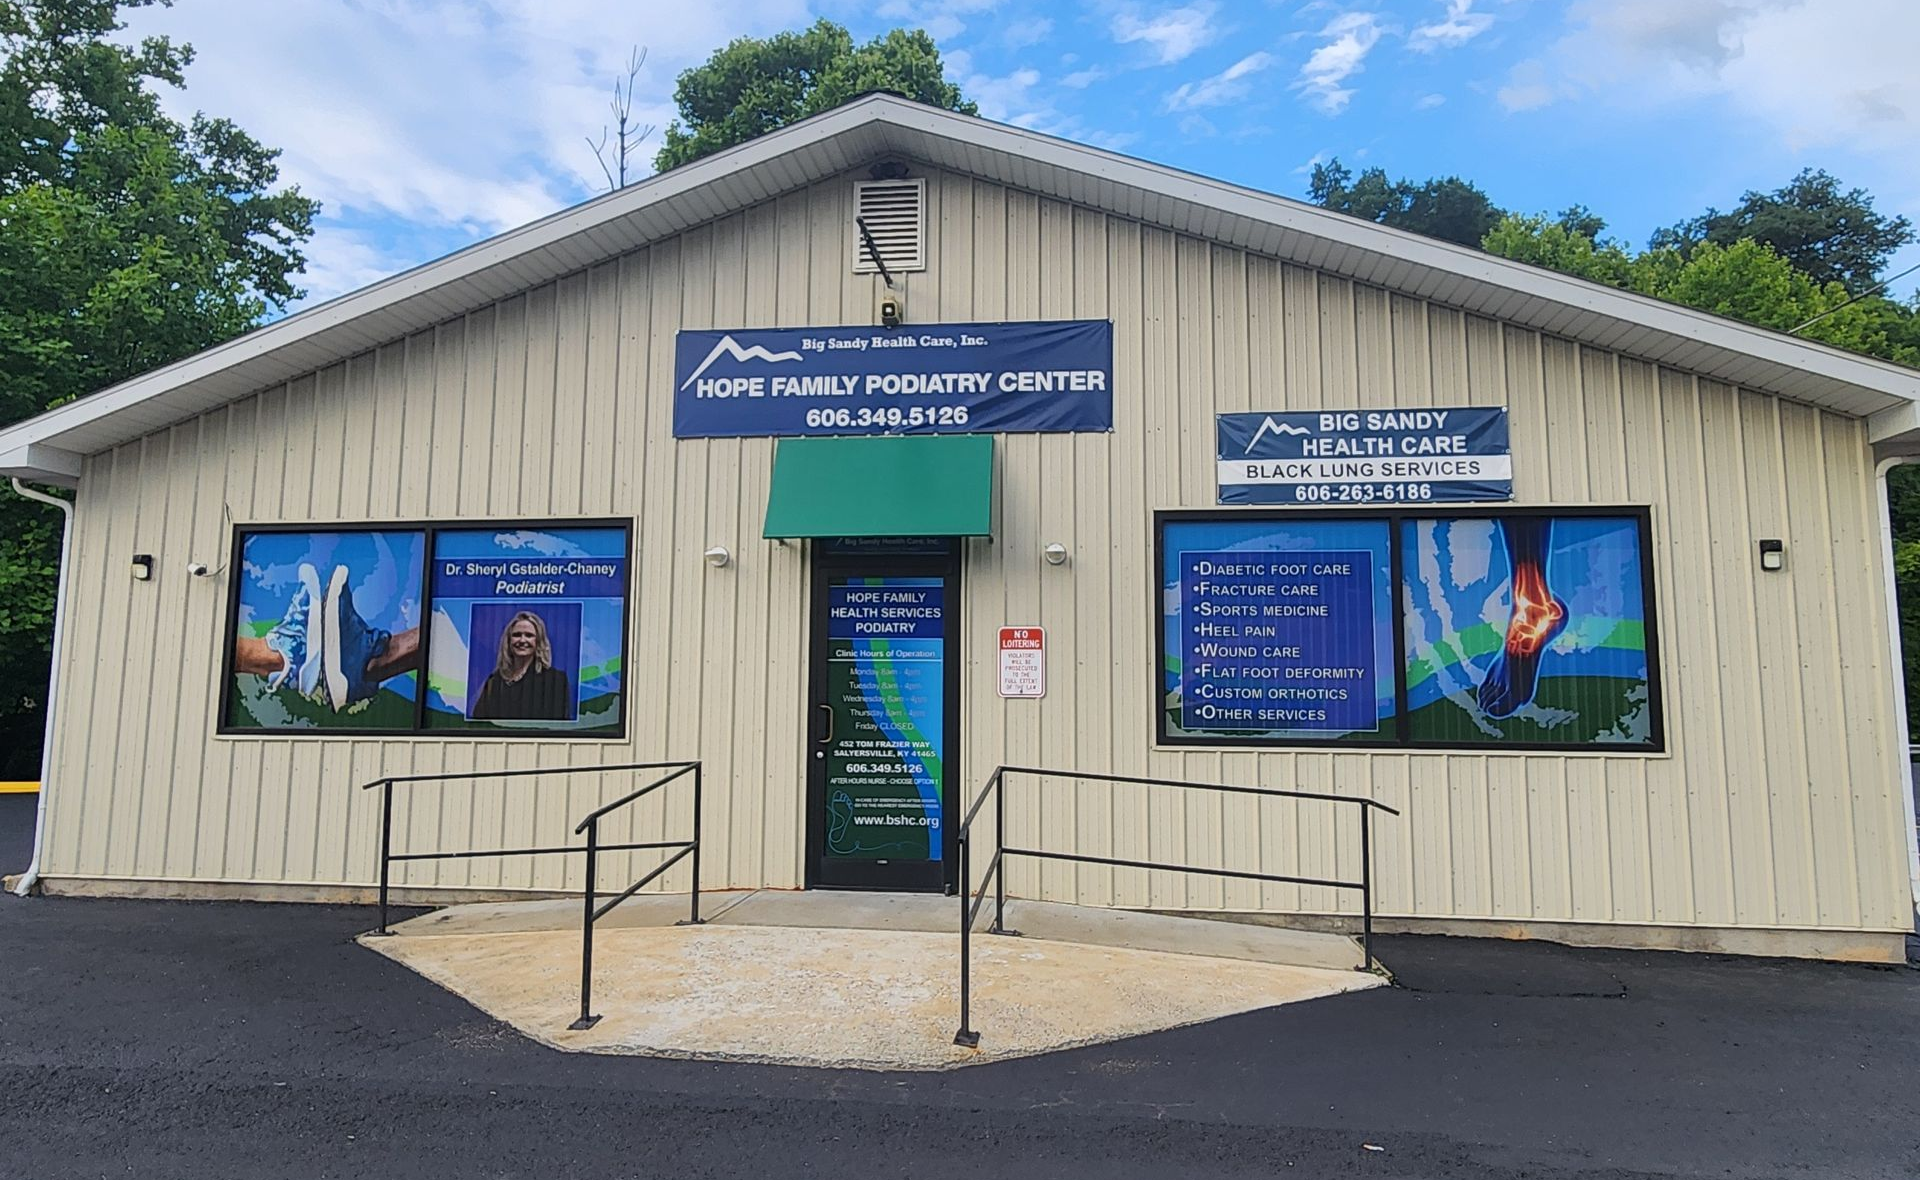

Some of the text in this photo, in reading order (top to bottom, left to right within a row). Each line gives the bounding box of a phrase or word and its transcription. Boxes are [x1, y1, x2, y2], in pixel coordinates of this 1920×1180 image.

[802, 334, 988, 352] Big Sandy Health Care, Inc.
[697, 369, 1106, 398] HOPE FAMILY PODIATRY CENTER
[805, 405, 969, 428] 606.349.5126
[1319, 411, 1449, 432] BIG SANDY
[1303, 435, 1467, 456] HEALTH CARE
[1246, 461, 1481, 479] BLACK LUNG SERVICES
[1295, 484, 1431, 501] 606-263-6186
[446, 562, 616, 578] Dr. Sheryl Gstalder-Chaney
[1271, 565, 1308, 576] FOOT
[1313, 564, 1351, 576] CARE
[495, 581, 565, 594] Podiatrist
[1281, 585, 1319, 596] CARE
[846, 592, 926, 603] HOPE FAMILY
[831, 607, 941, 619] HEALTH SERVICES
[1263, 605, 1329, 617] MEDICINE
[855, 622, 916, 634] PODIATRY
[1245, 626, 1276, 637] PAIN
[1014, 630, 1028, 639] NO
[1002, 640, 1040, 648] LOITERING
[895, 650, 935, 658] Operation
[1263, 646, 1300, 658] CARE
[849, 668, 879, 676] Monday
[1242, 667, 1280, 679] FOOT
[1285, 668, 1365, 680] DEFORMITY
[849, 681, 879, 690] Tuesday
[843, 695, 886, 703] Wednesday
[1268, 688, 1348, 700] ORTHOTICS
[850, 709, 883, 717] Thursday
[1258, 709, 1326, 721] SERVICES
[855, 722, 914, 731] Friday CLOSED
[833, 750, 896, 758] SALYERSVILLE,
[846, 763, 923, 773] 606.349.5126
[854, 814, 940, 828] www.bshc.org
